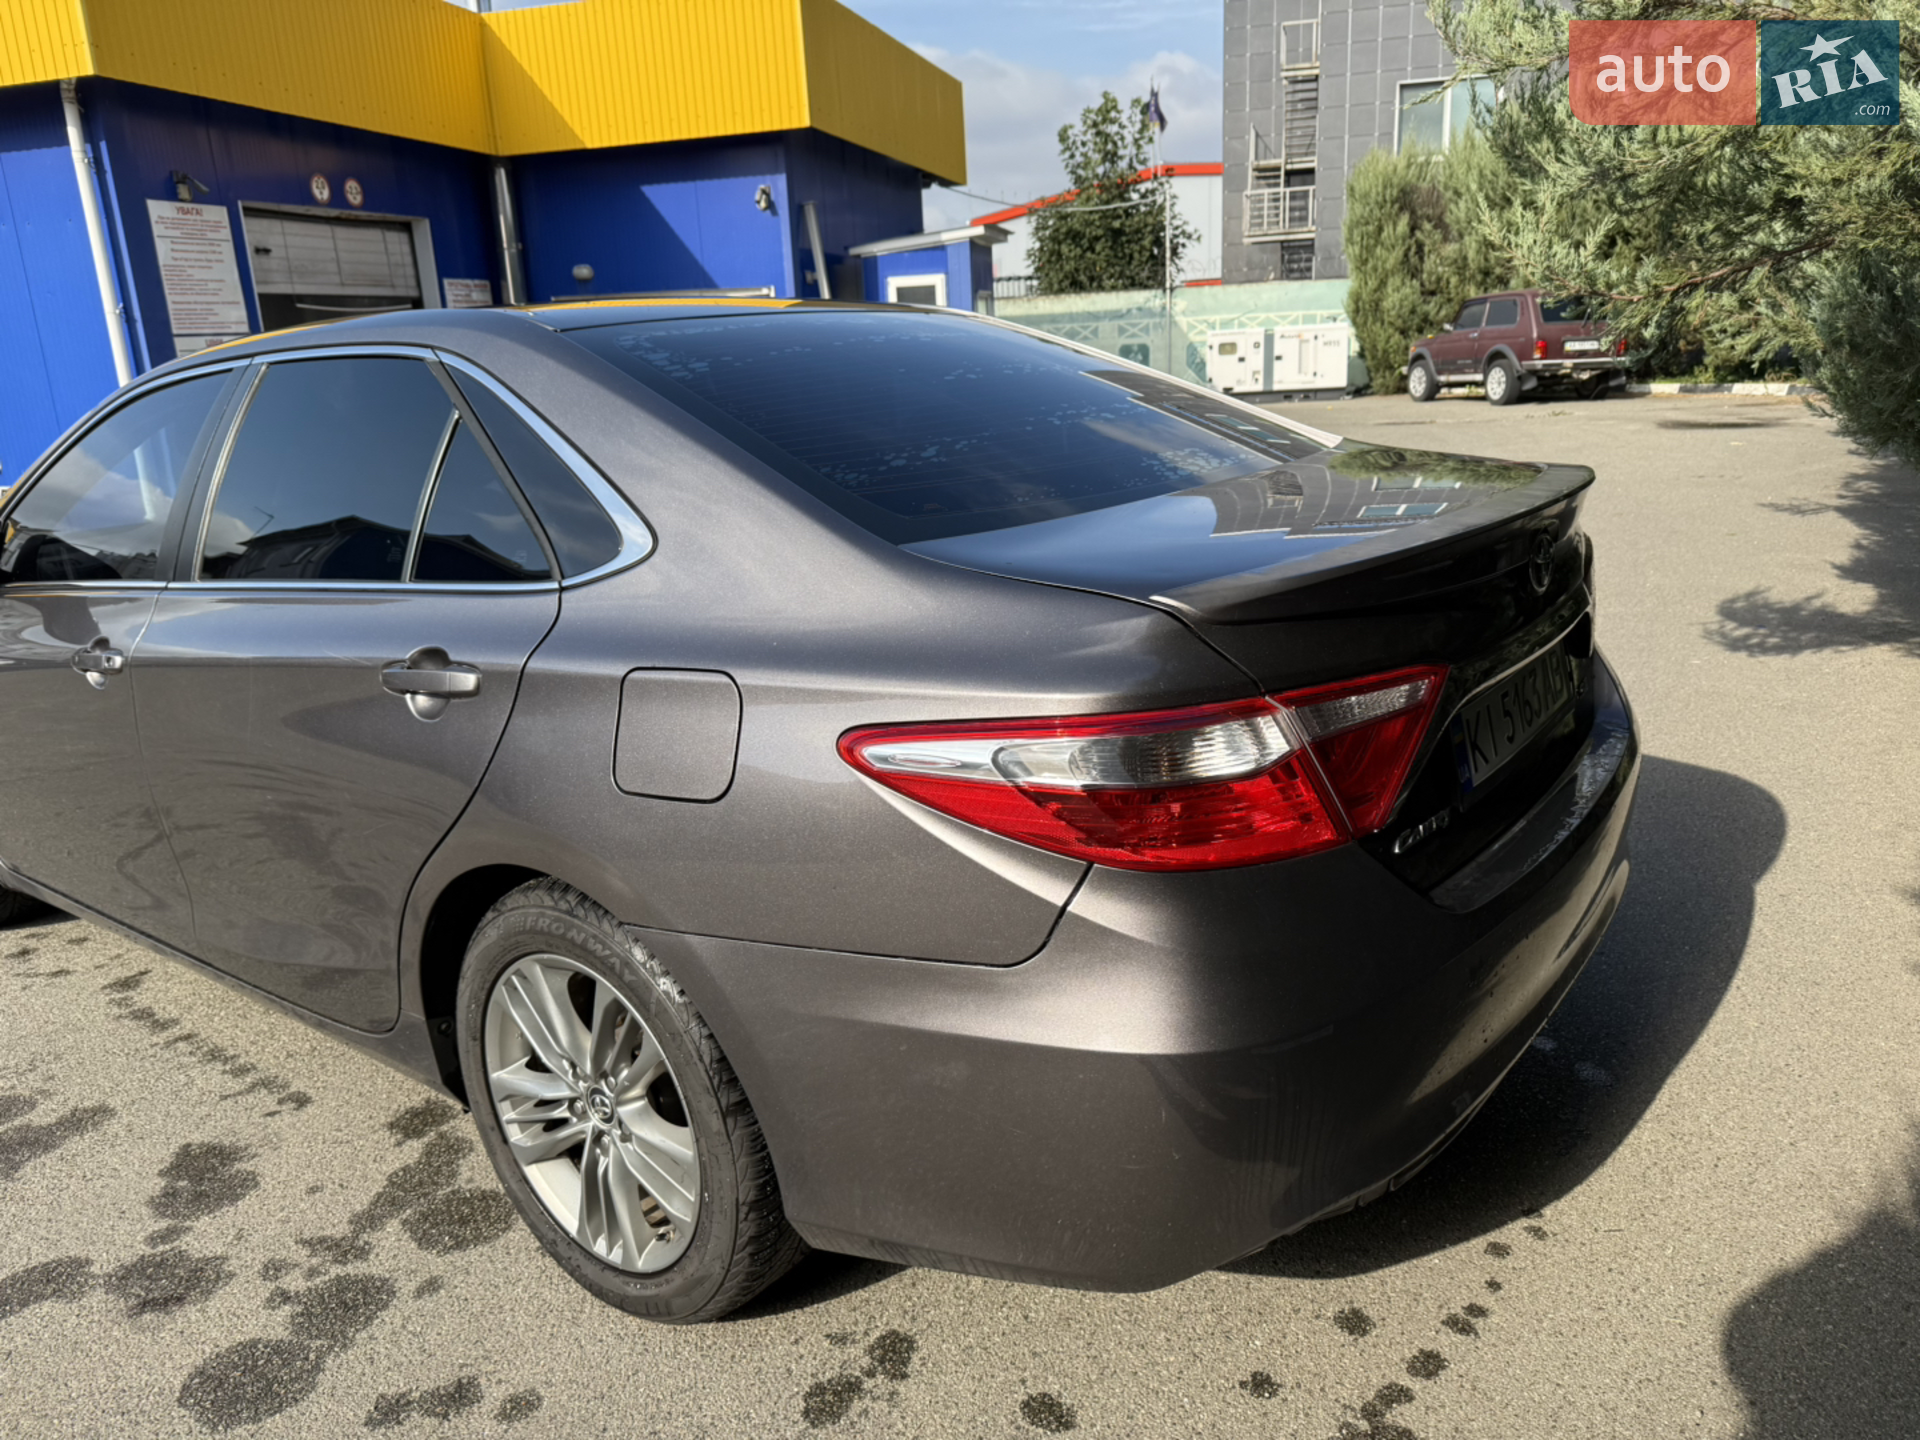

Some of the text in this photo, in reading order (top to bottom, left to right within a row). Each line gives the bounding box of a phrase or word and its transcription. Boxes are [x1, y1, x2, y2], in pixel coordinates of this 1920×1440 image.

[175, 206, 203, 216] УВАГА!
[1466, 704, 1497, 773] KI
[1500, 668, 1542, 744] 5163
[524, 916, 638, 982] FRONWAY
